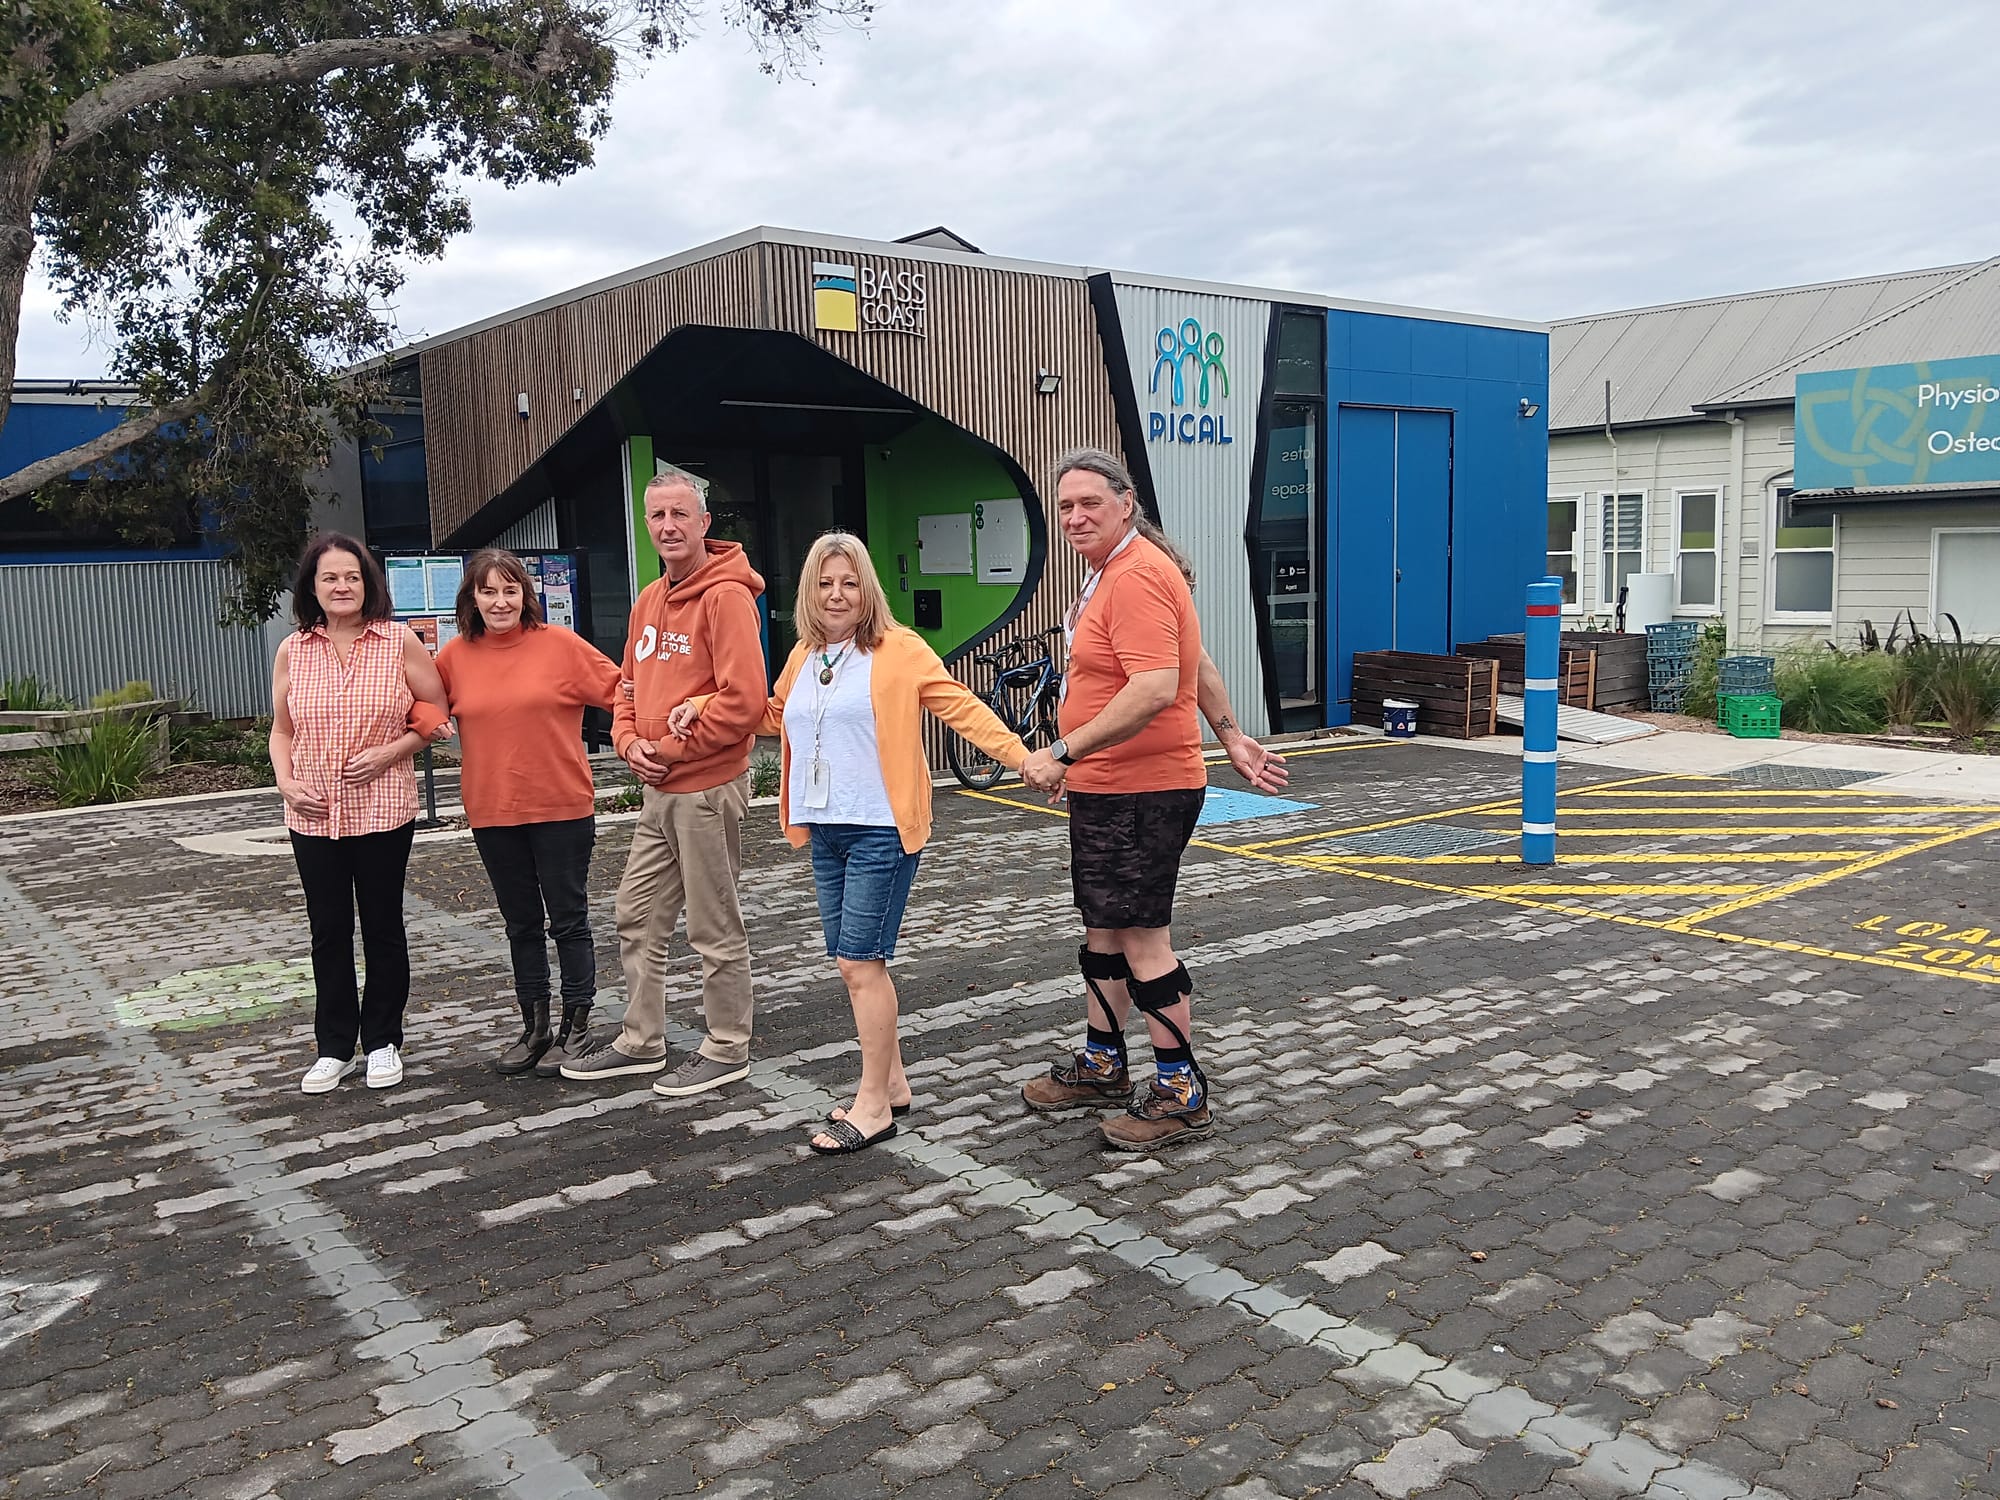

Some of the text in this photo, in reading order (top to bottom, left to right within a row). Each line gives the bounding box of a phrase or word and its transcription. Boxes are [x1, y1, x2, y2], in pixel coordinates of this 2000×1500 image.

[861, 267, 927, 304] BASS
[863, 302, 927, 329] COAST
[1918, 383, 2000, 410] Physio
[1148, 411, 1233, 444] PICAL
[680, 645, 691, 655] BE
